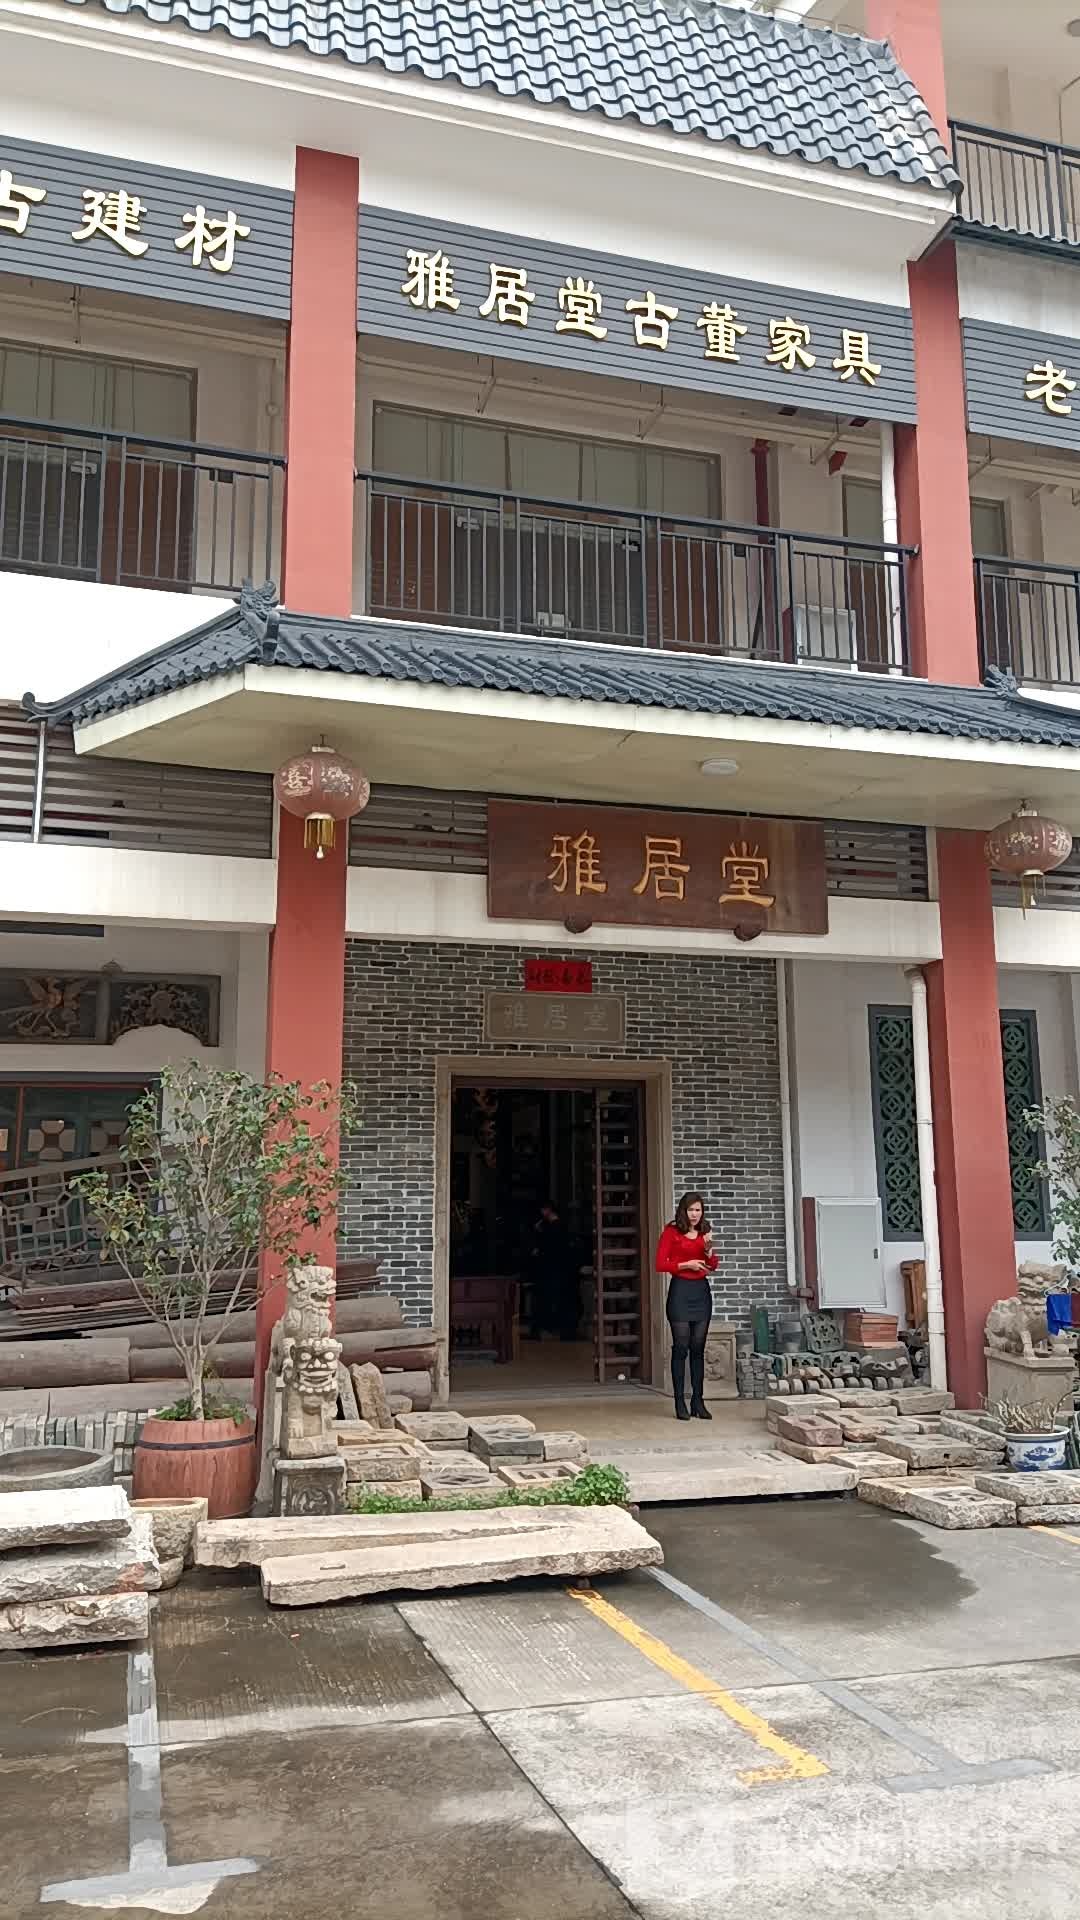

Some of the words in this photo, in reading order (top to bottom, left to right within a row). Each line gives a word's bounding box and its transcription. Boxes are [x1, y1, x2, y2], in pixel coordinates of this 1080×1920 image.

[0, 169, 250, 272] 古建材
[401, 248, 882, 386] 雅居堂古董家具
[1025, 359, 1077, 414] 老
[547, 829, 776, 908] 雅居堂
